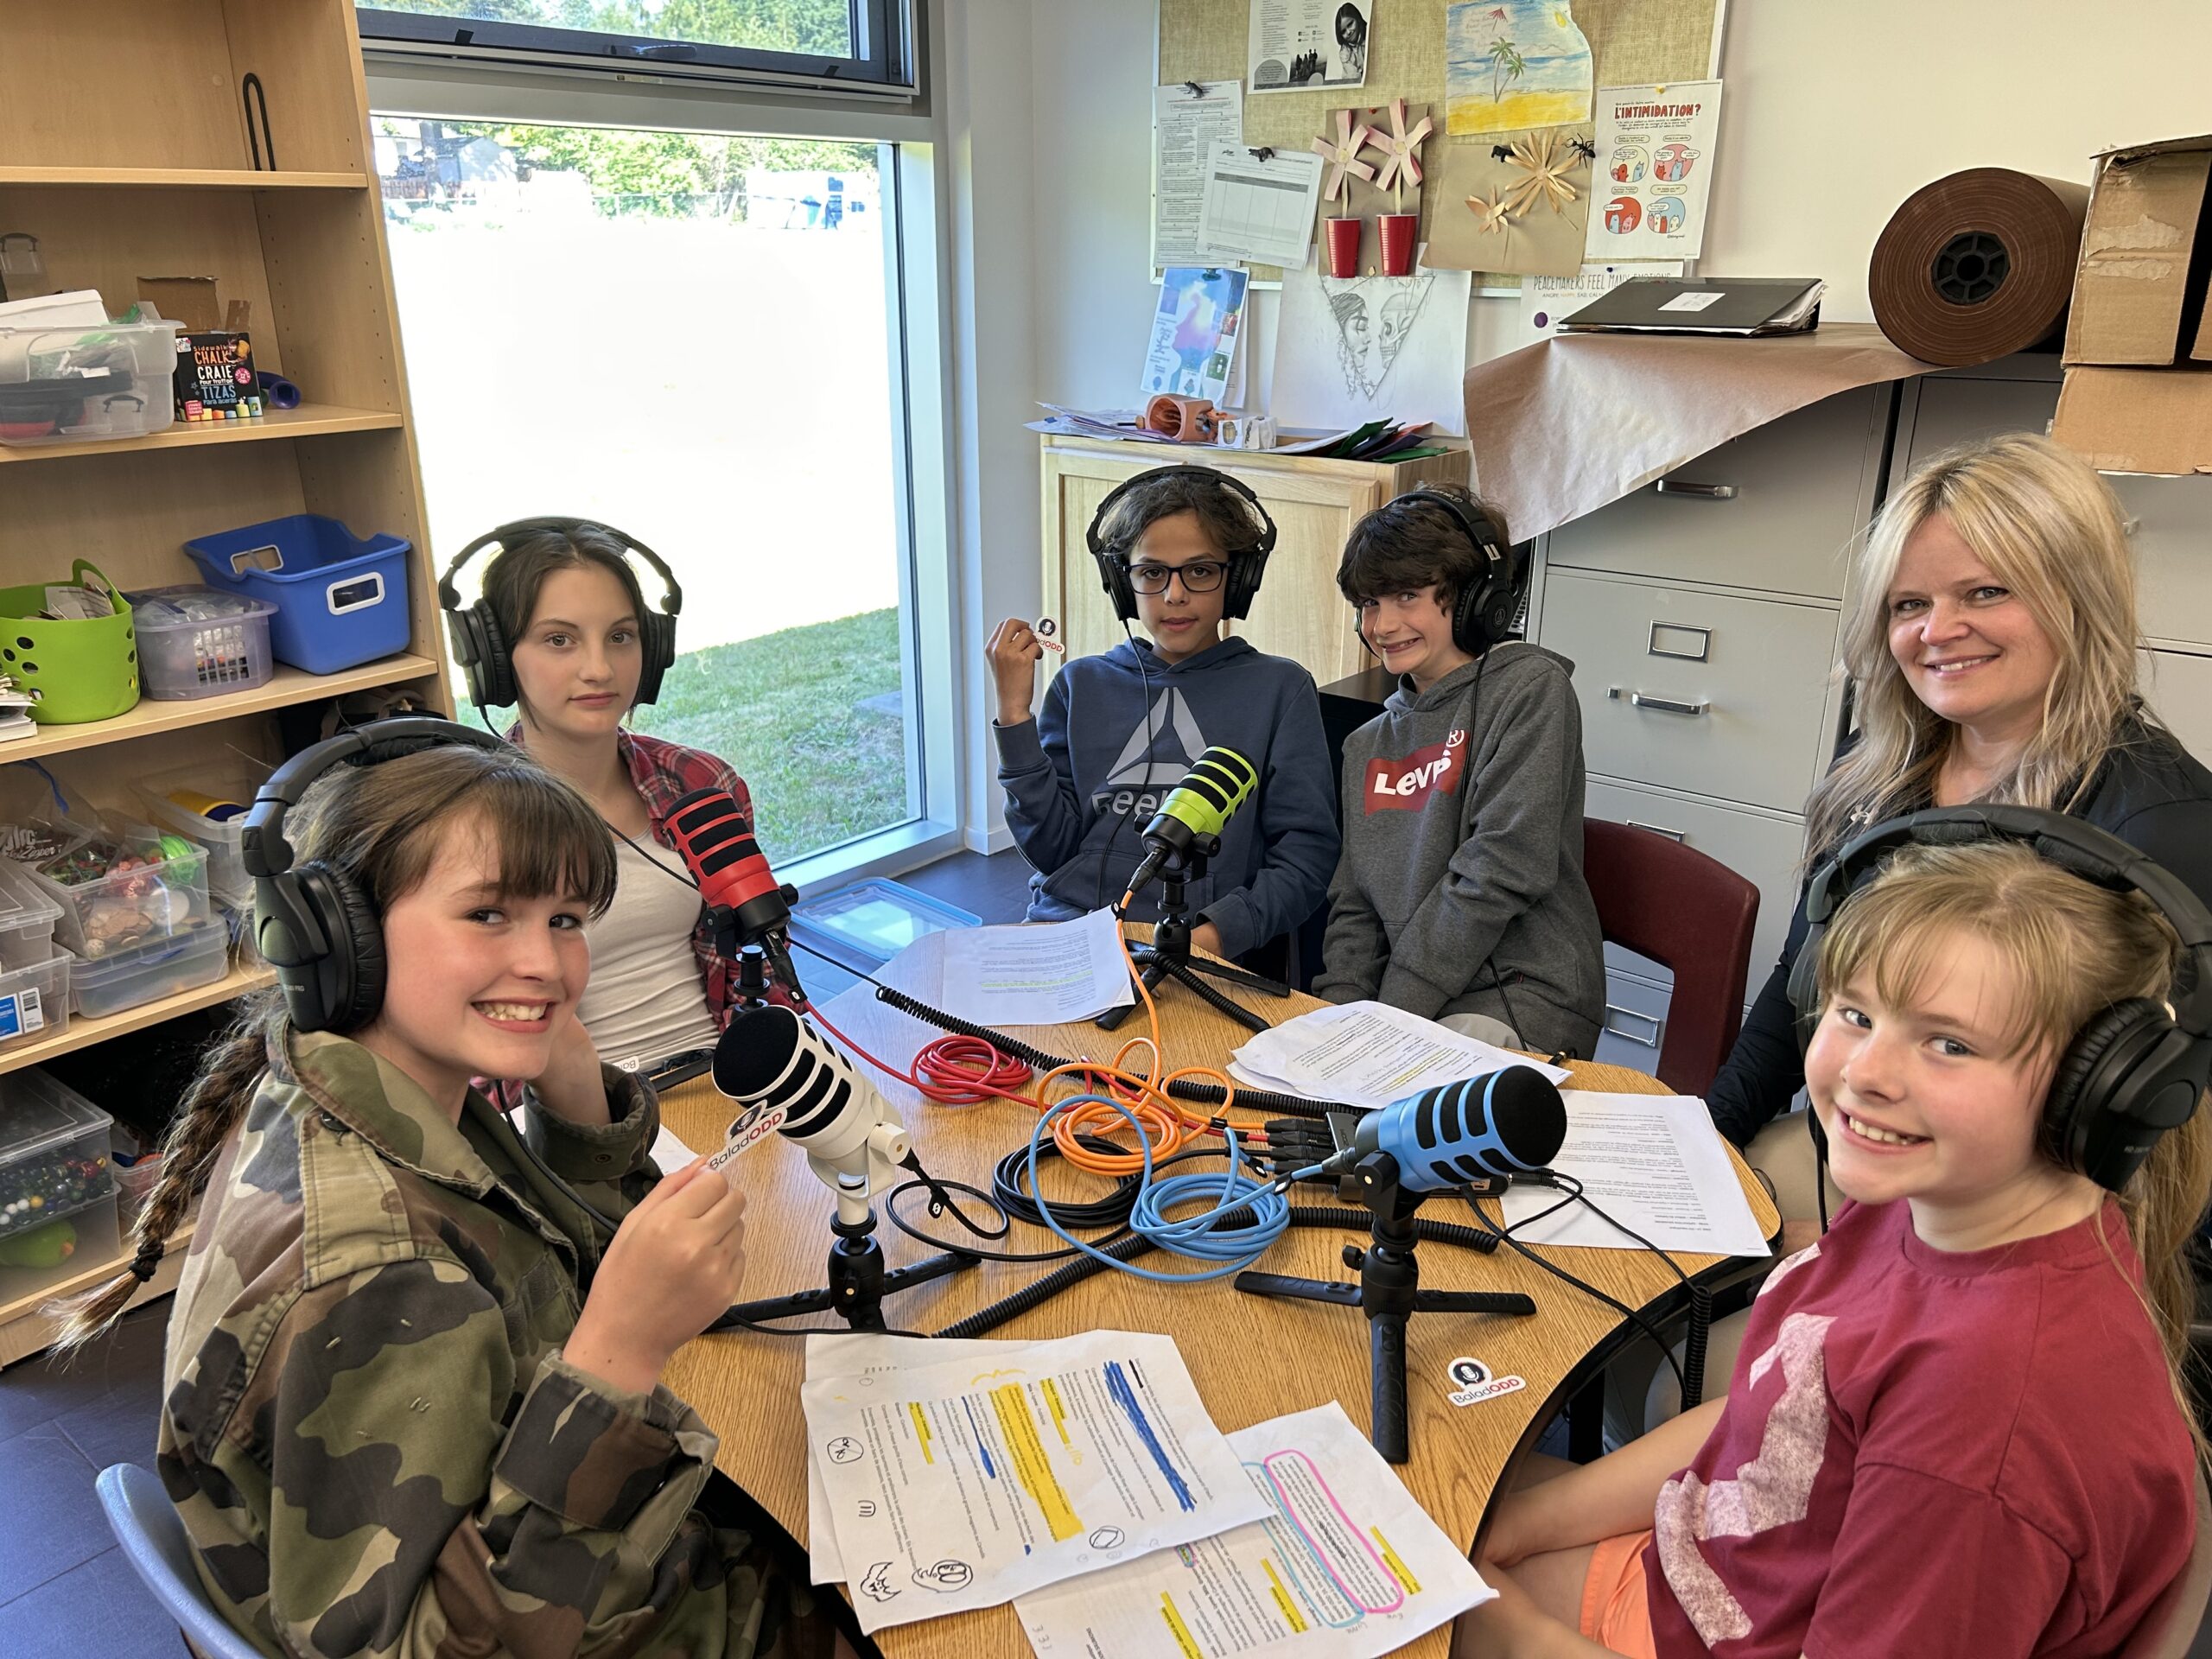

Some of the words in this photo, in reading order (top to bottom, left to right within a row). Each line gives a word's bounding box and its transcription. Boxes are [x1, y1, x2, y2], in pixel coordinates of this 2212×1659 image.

[1534, 275, 1585, 290] PEACEMAKERS
[1587, 275, 1605, 289] FEEL
[194, 351, 229, 365] CHALK
[197, 365, 233, 379] CRAIE
[200, 385, 236, 399] TIZAS
[709, 1111, 783, 1169] BaladODD
[1453, 1376, 1522, 1404] BaladODD
